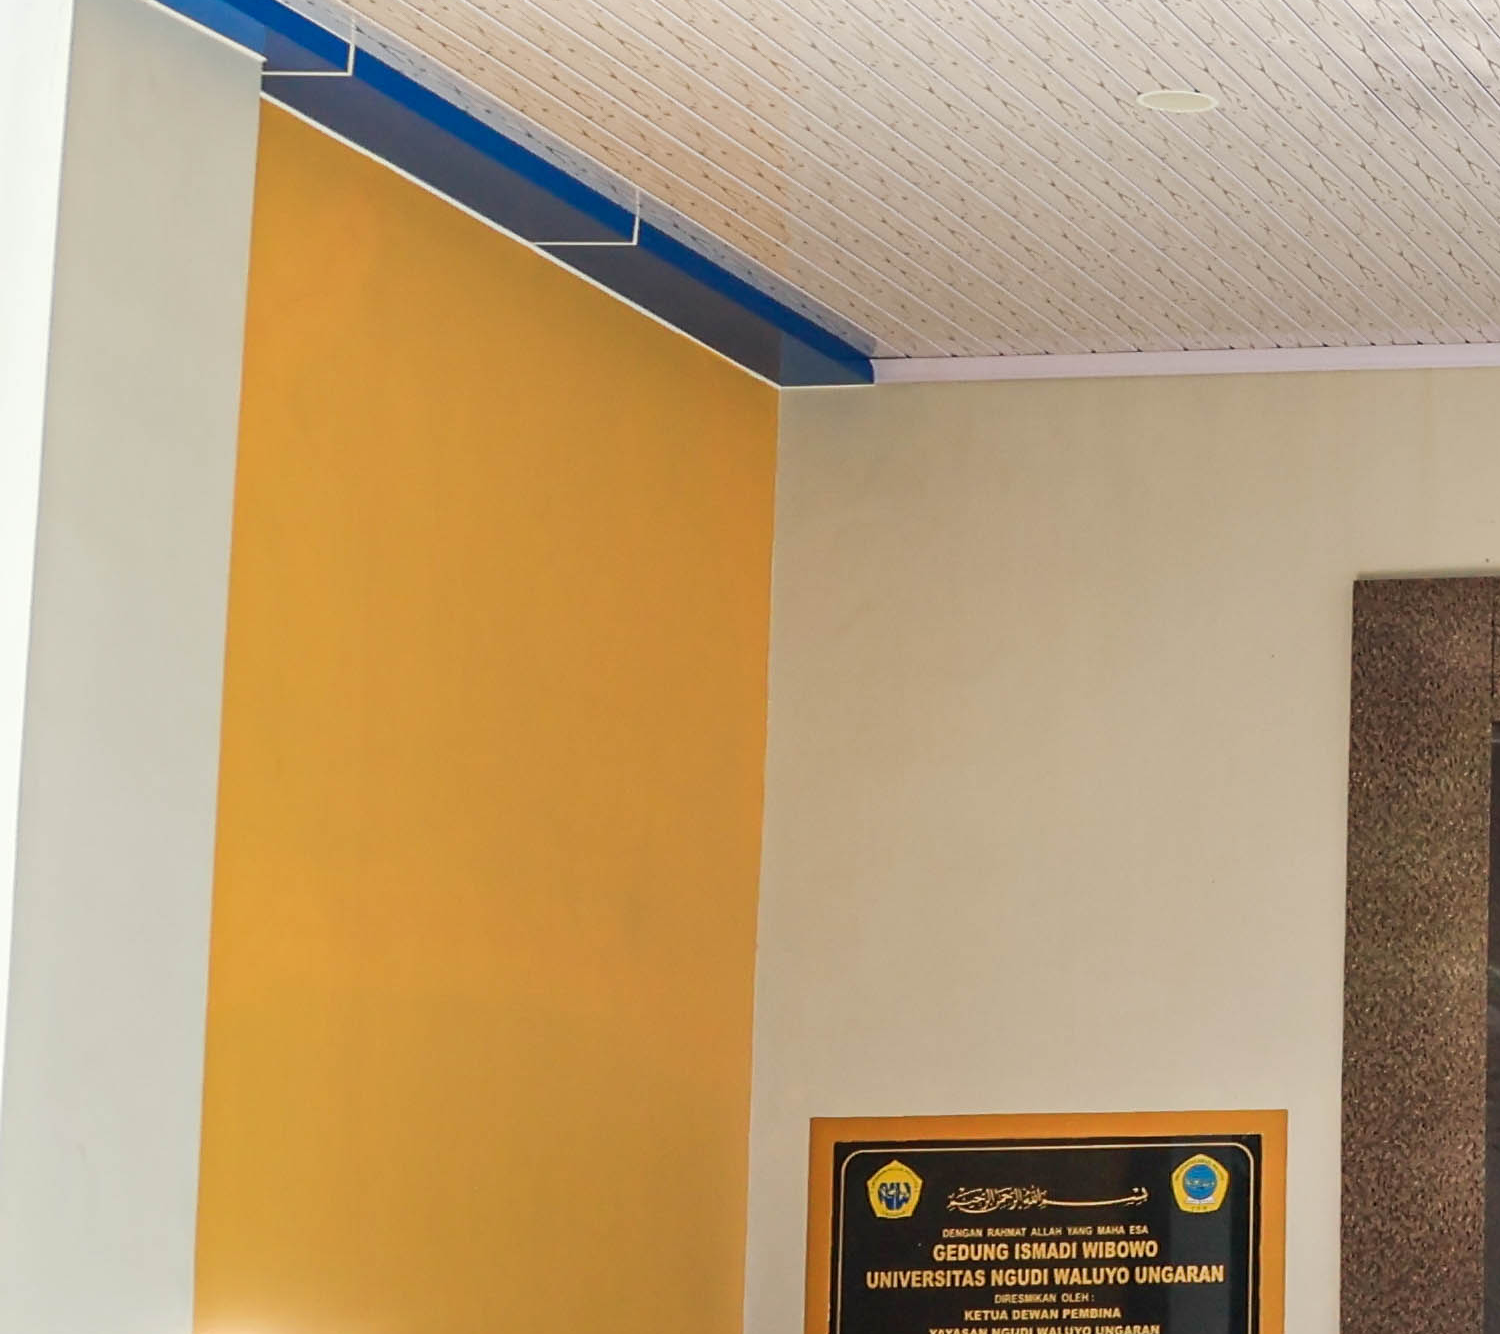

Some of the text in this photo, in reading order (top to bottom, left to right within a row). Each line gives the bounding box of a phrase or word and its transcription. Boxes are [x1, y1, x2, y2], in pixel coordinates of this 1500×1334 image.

[942, 1225, 1149, 1238] DENGAN RAHMAT ALLAH YANG MAHA ESA
[933, 1240, 1159, 1261] GEDUNG ISMADI WIBOWO
[866, 1265, 1225, 1289] UNIVERSITAS NGUDI WALUYO UNGARAN
[994, 1293, 1056, 1304] DIRESMIKAN
[964, 1307, 1122, 1321] KETUA DEWAN PEMBINA
